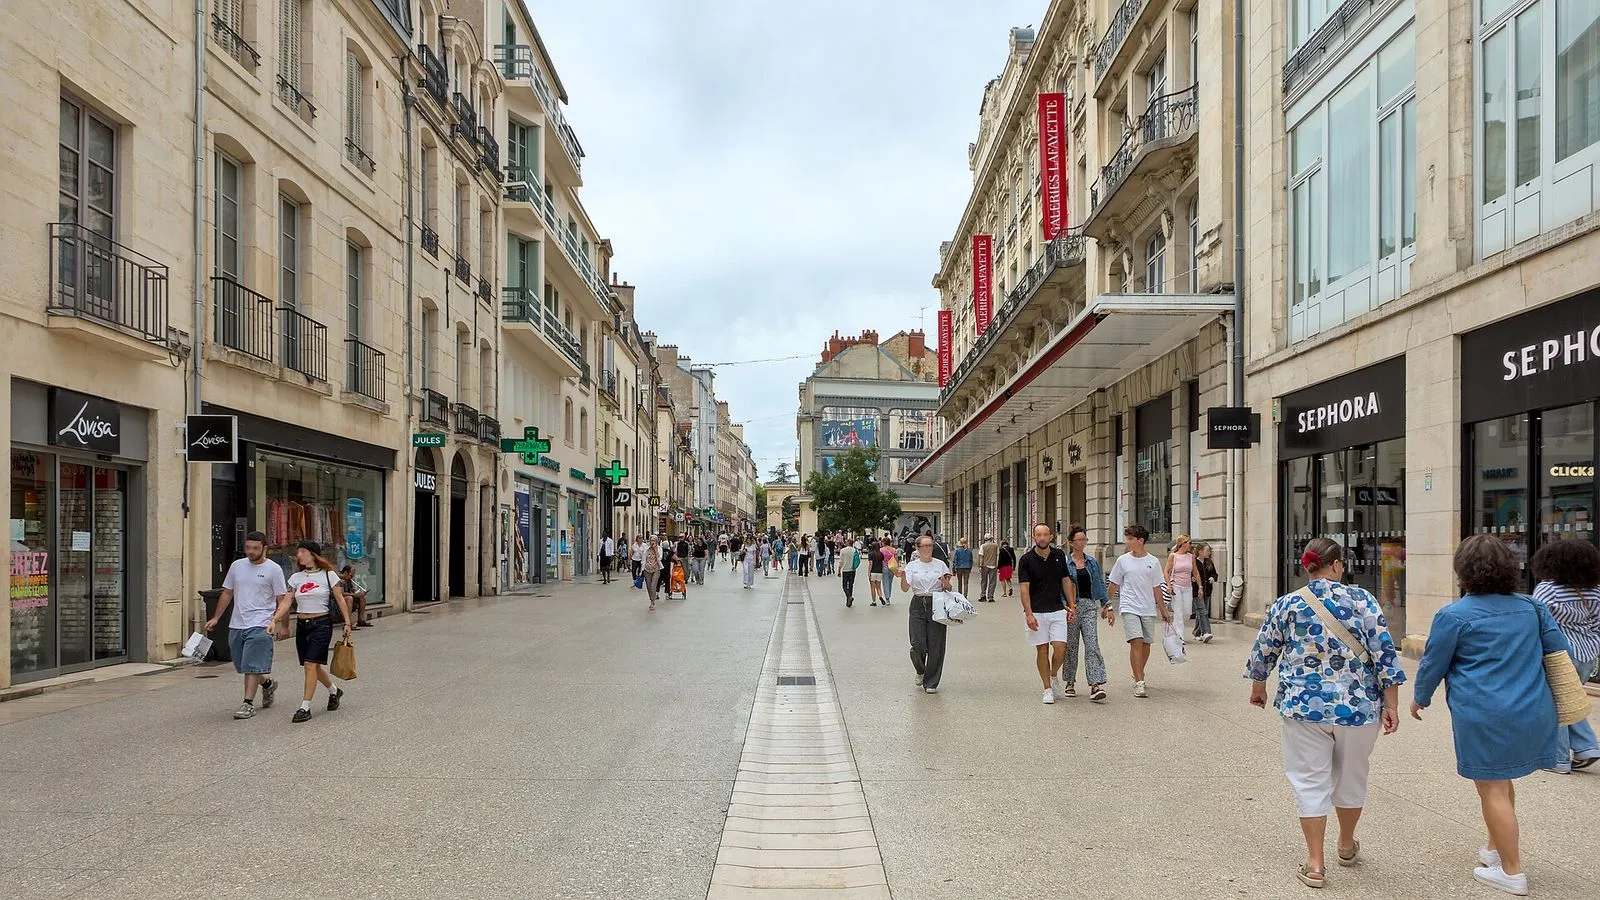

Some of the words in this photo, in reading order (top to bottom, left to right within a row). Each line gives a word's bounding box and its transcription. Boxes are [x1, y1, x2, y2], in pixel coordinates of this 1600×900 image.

[1046, 99, 1060, 171] LAFAYETTE
[1048, 175, 1061, 236] GALERIES
[978, 240, 987, 289] LAFAYETTE
[979, 291, 988, 333] GALERIES
[58, 400, 118, 446] Lovisa
[1297, 390, 1380, 434] SEPHORA
[190, 429, 230, 449] Lovisa
[415, 436, 441, 445] JULES
[414, 473, 436, 491] JULES
[614, 491, 630, 503] JD
